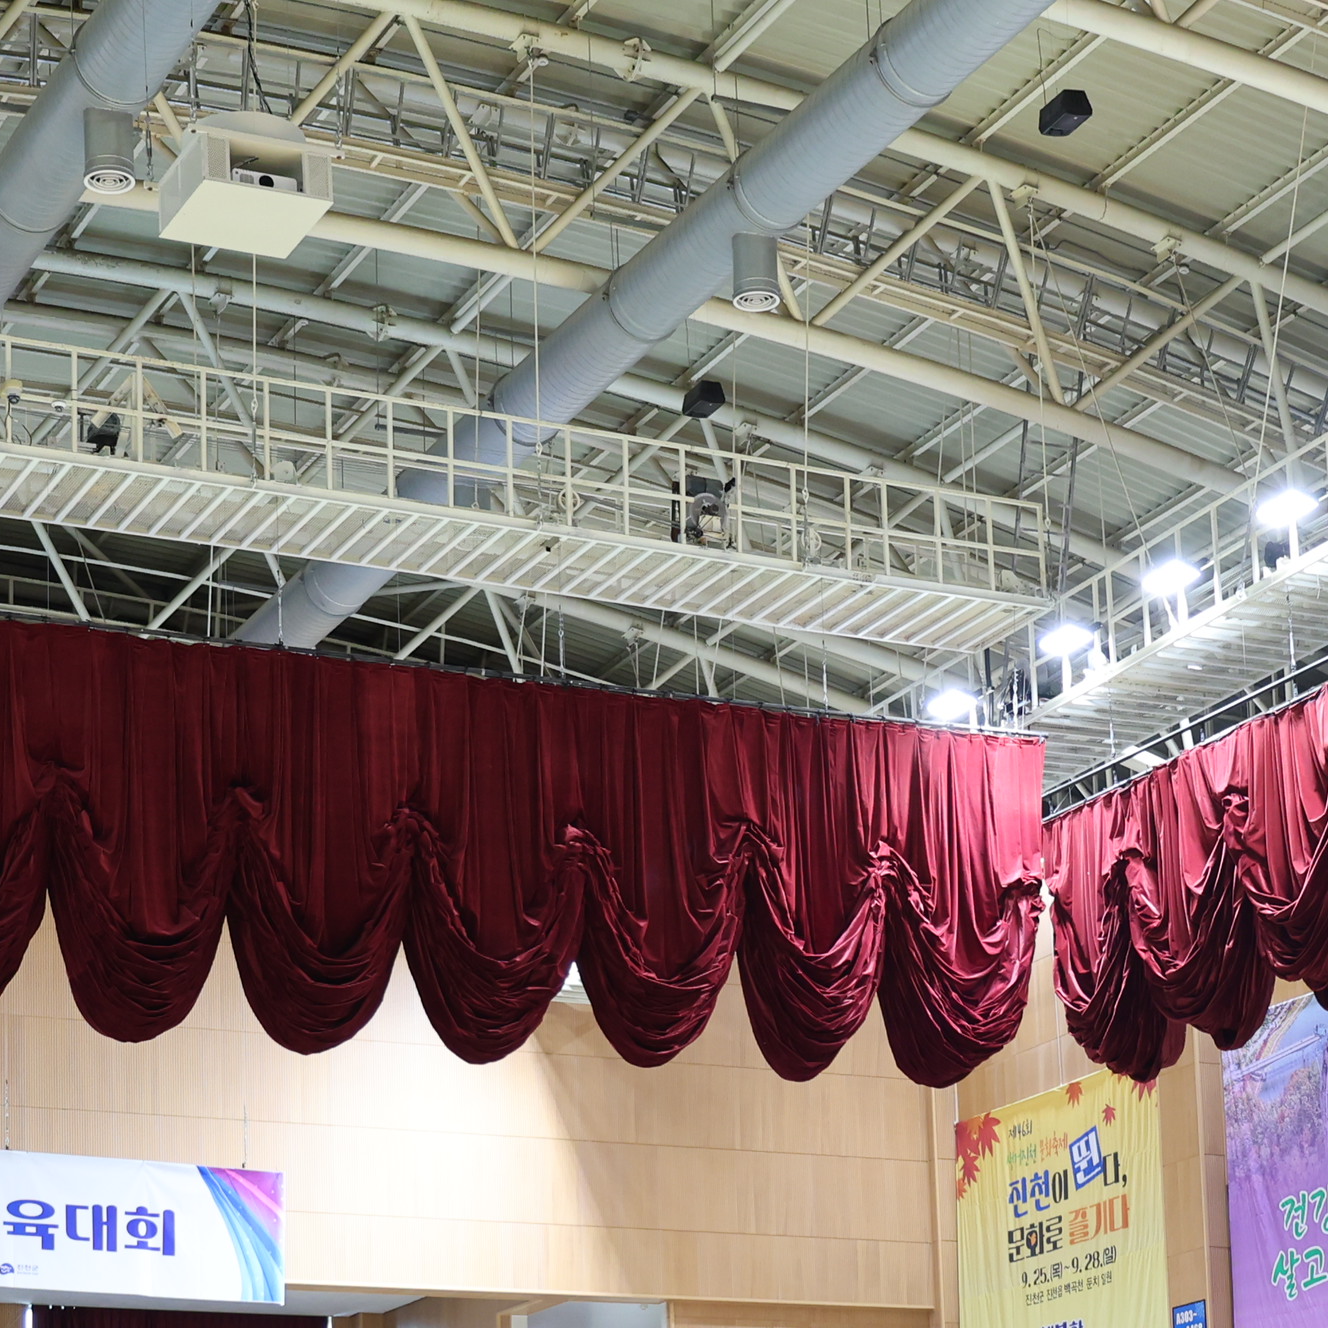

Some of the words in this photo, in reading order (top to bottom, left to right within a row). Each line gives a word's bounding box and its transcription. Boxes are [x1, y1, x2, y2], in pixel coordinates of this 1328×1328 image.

[1008, 1168, 1069, 1218] 진천이
[1007, 1214, 1064, 1263] 문화로
[1068, 1193, 1130, 1246] 즐기다
